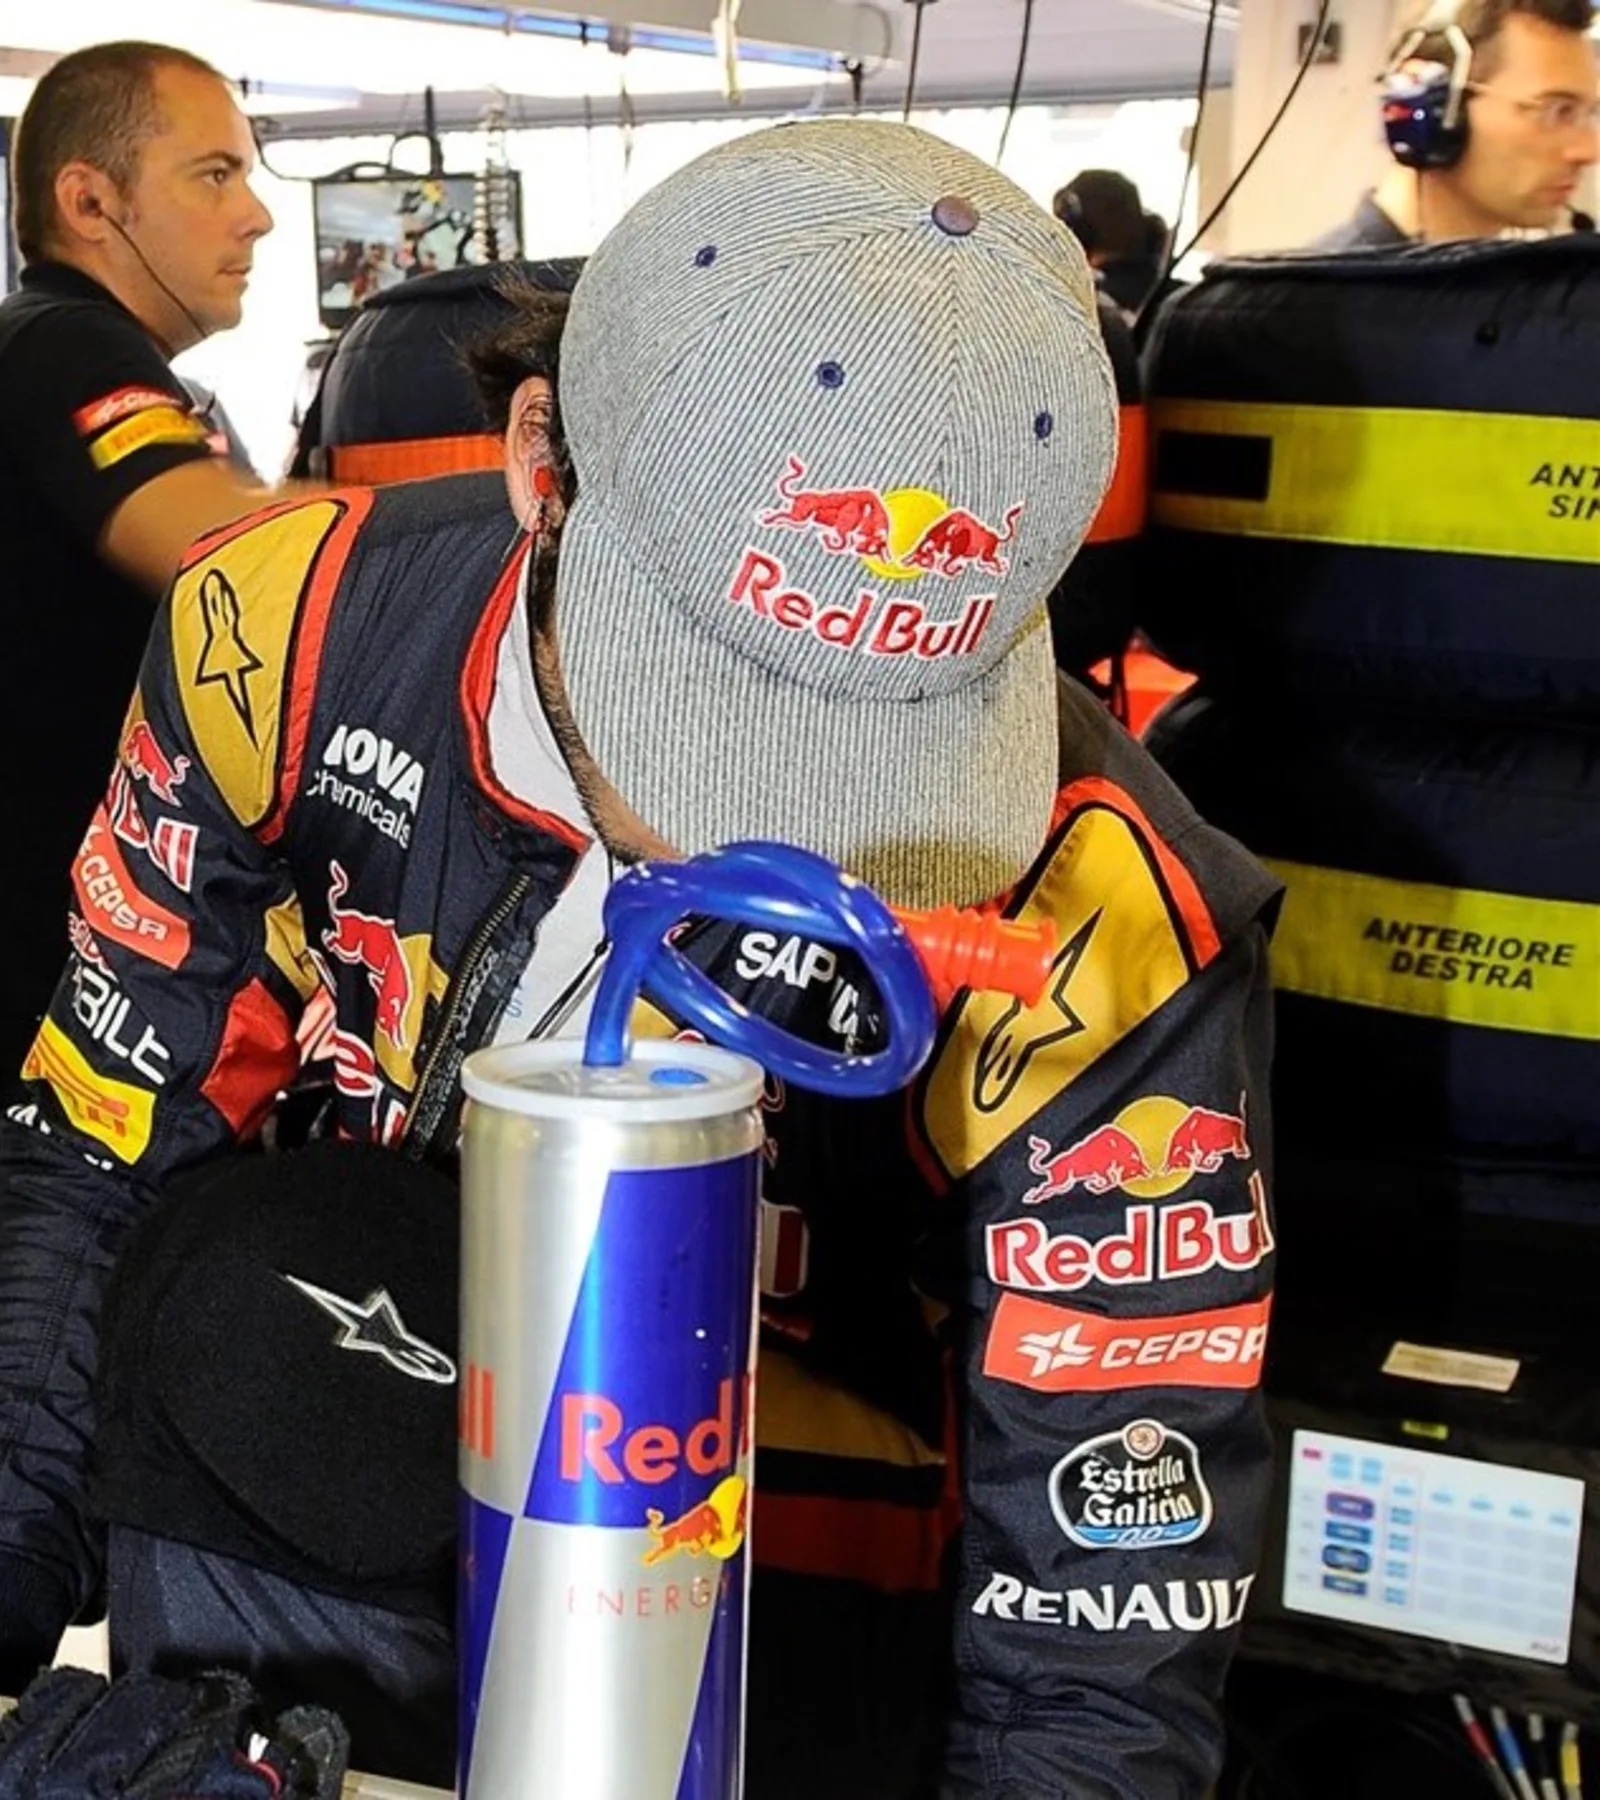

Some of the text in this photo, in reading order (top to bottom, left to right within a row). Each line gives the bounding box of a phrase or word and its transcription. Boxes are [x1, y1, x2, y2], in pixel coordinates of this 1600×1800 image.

[728, 547, 997, 660] Red Bull
[80, 855, 169, 942] CEPSA
[1364, 917, 1575, 967] ANTERIORE
[1390, 951, 1534, 990] DESTRA
[986, 1205, 1154, 1292] Red
[560, 1377, 732, 1485] Red
[1078, 1453, 1186, 1494] Estrella
[1083, 1489, 1197, 1528] Galicia
